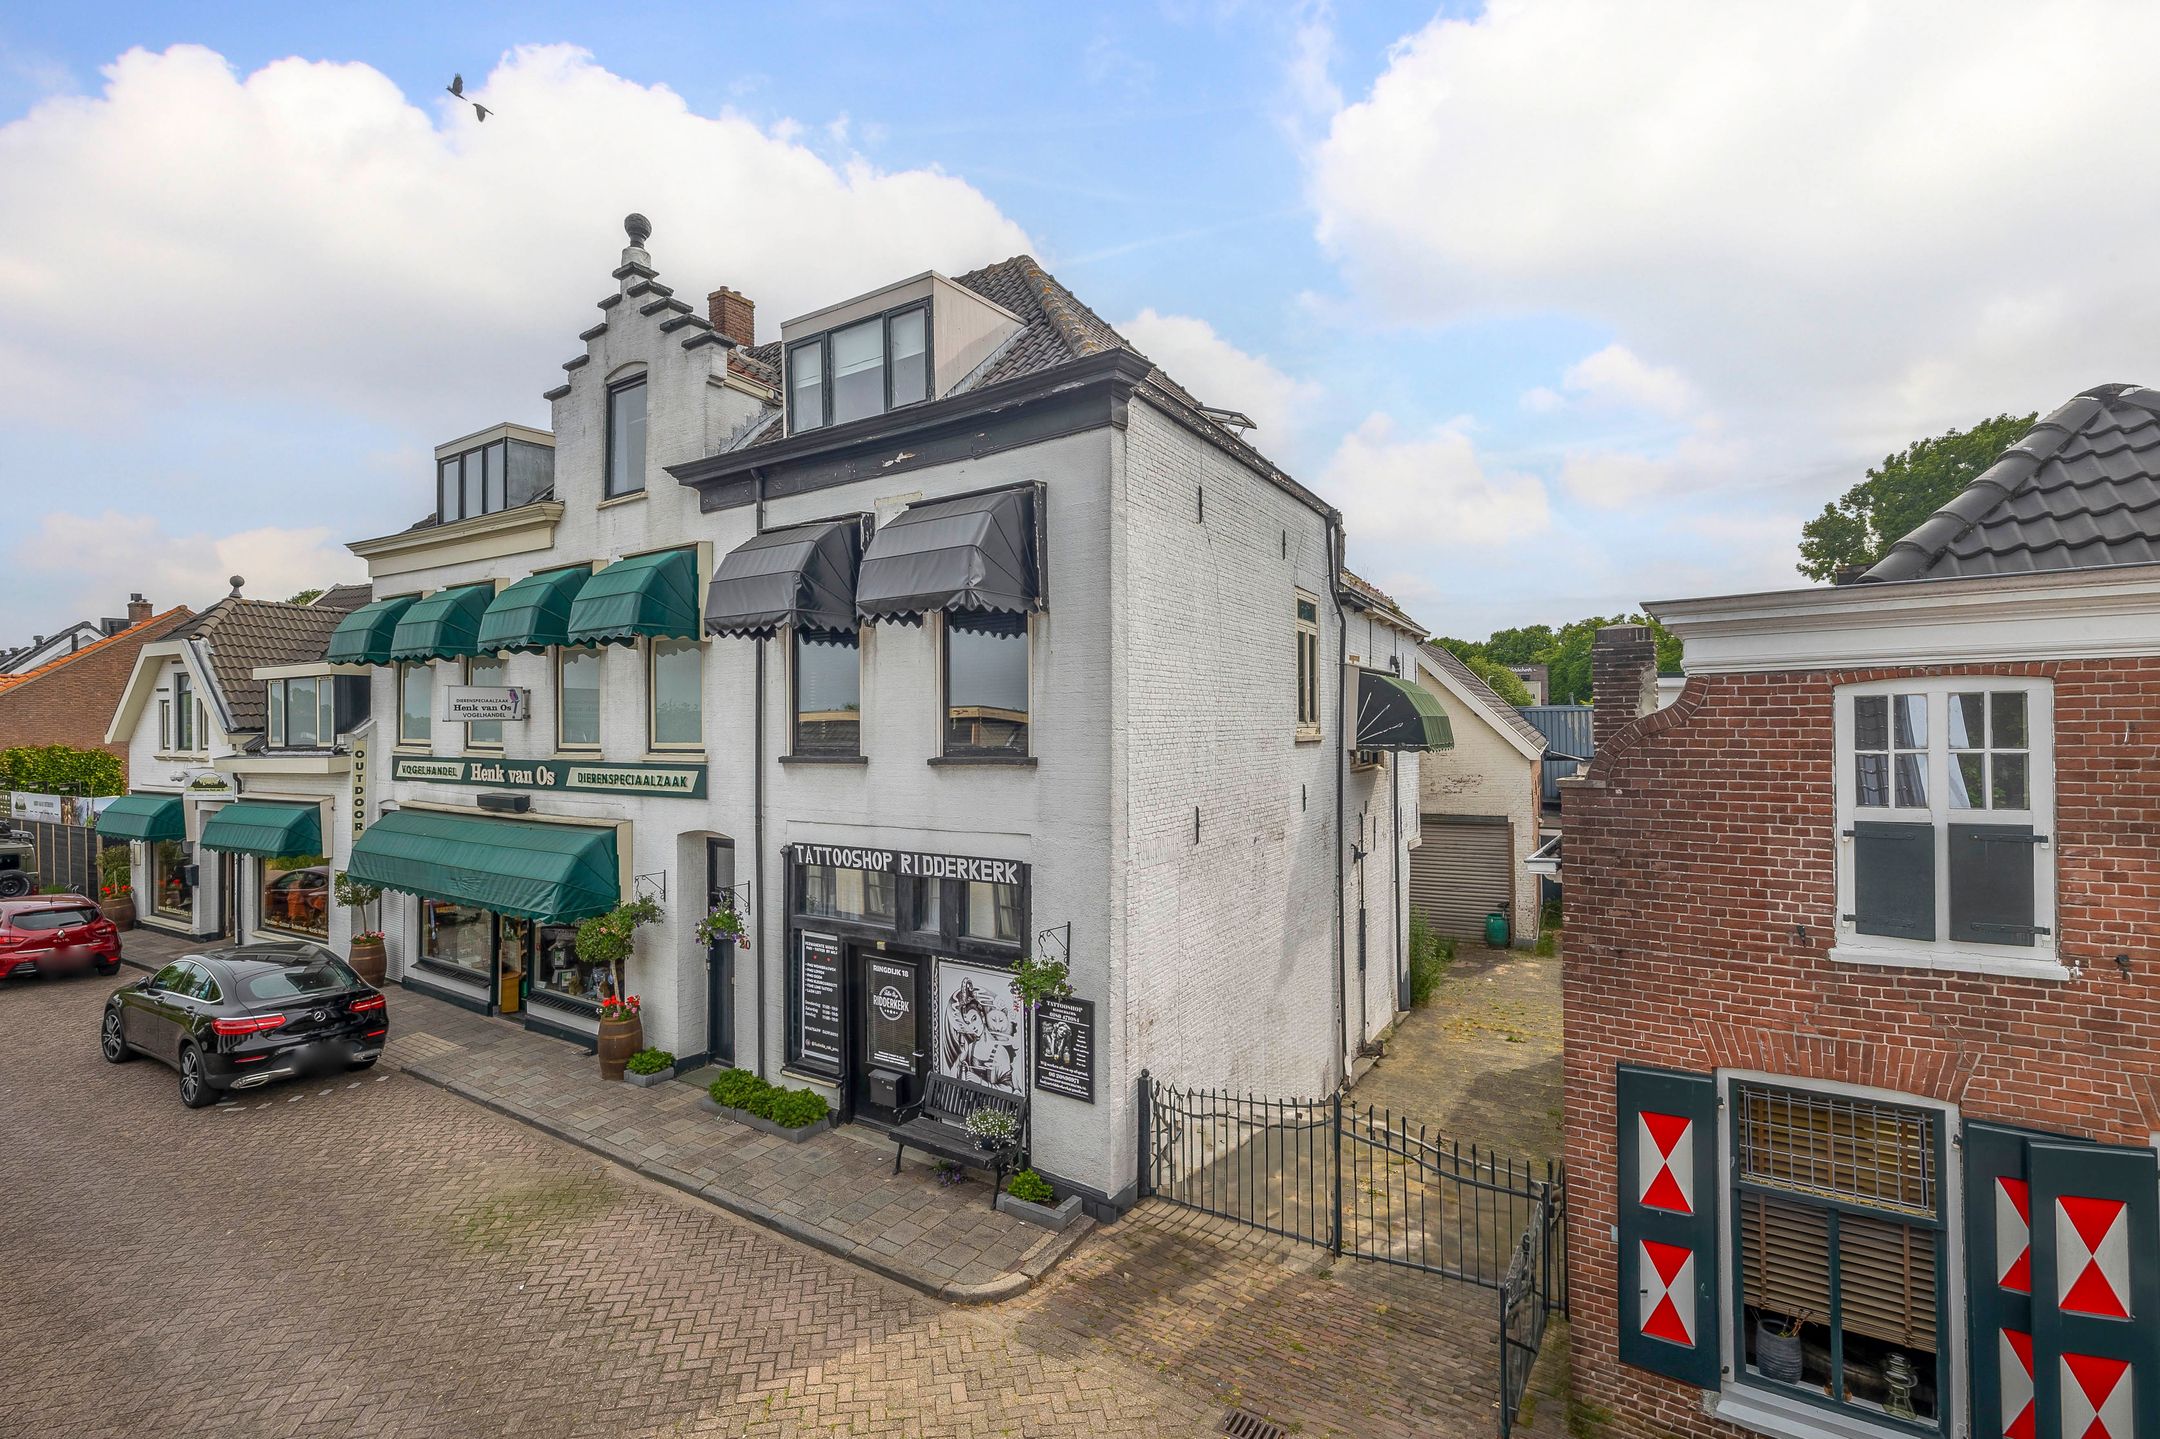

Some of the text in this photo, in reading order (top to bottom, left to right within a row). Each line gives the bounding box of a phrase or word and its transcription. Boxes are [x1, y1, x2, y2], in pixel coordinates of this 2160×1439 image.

[401, 762, 688, 788] VOGELHANDEL Henk van Os DIERENSPECIAALZAAK
[354, 750, 365, 831] OUTDOOR
[794, 844, 1019, 885] TATTOOSHOP RIDDERKERK
[872, 964, 902, 976] RINGDIJK
[873, 994, 910, 1013] RIDDERKERK
[1046, 1000, 1083, 1013] TATTOOSHOP
